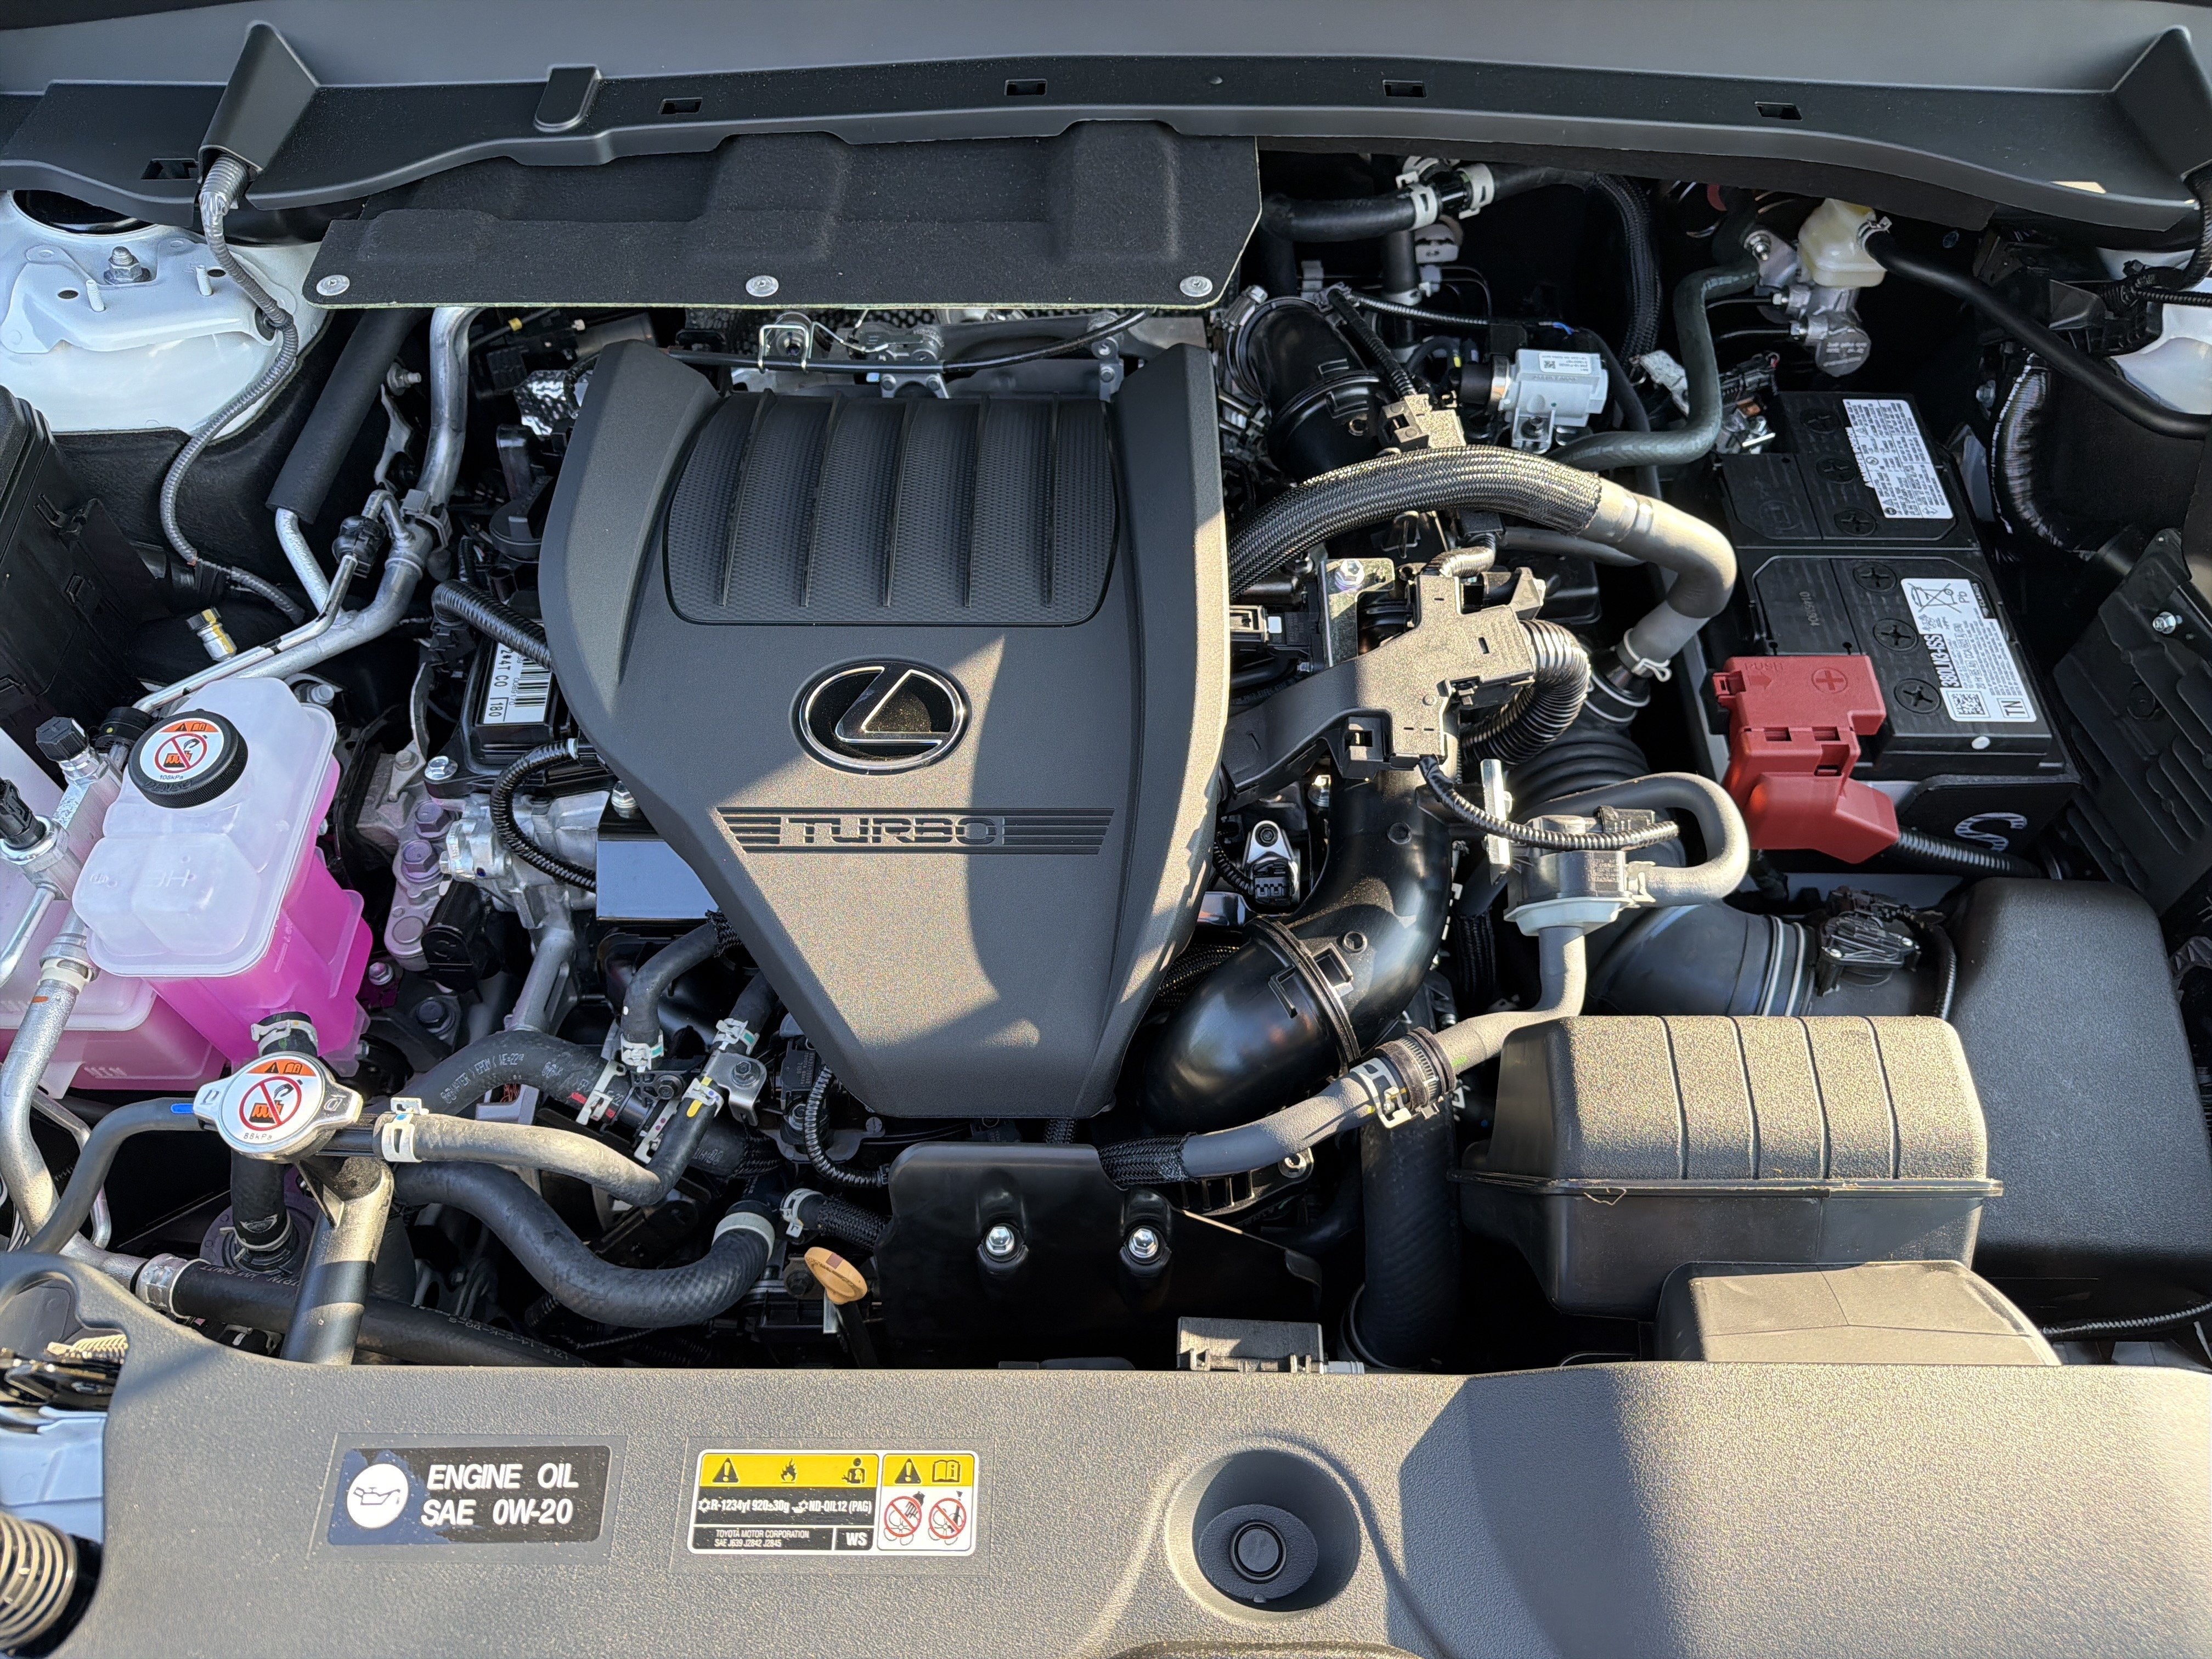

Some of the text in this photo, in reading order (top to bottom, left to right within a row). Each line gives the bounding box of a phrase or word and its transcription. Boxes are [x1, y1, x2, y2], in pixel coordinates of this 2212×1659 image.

[1957, 591, 1970, 603] Pb
[1924, 634, 1960, 688] 380LN3-ISS
[489, 702, 504, 716] 180
[2001, 700, 2025, 716] TN
[785, 817, 996, 845] TURBO
[427, 1462, 579, 1490] ENGINE OIL
[421, 1498, 573, 1526] SAE 0W-20
[710, 1499, 751, 1513] R-1234yf
[849, 1500, 872, 1514] (PAG)
[714, 1539, 782, 1548] SAE J639 J2842 J2845
[716, 1530, 867, 1547] TOYOTA MOTOR CORPORATION WS
